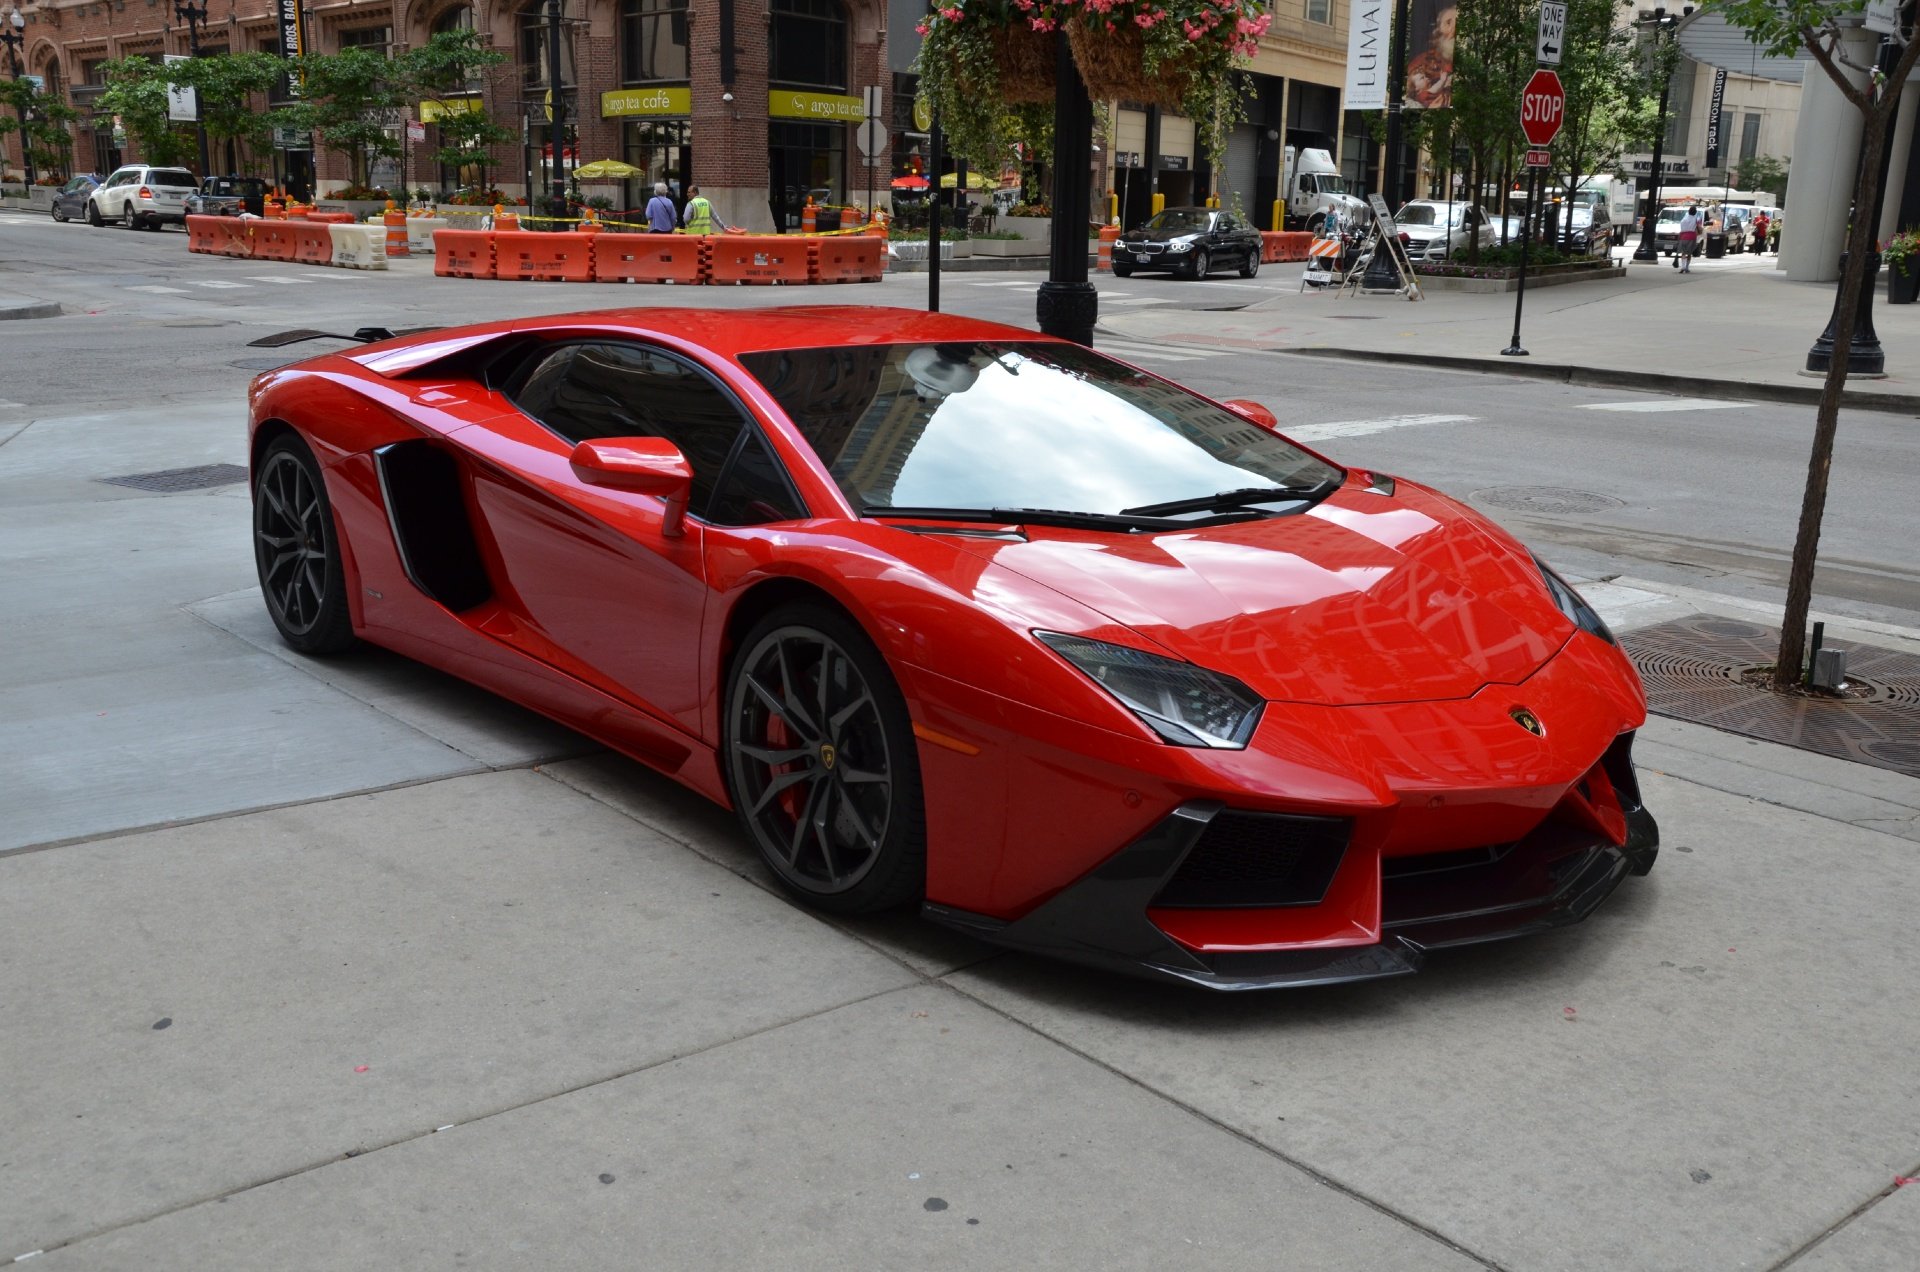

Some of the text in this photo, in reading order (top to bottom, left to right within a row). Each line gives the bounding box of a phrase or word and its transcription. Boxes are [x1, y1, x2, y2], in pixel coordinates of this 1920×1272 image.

[1544, 7, 1563, 23] ONE
[285, 23, 298, 49] BROS.
[1542, 23, 1562, 40] WAY
[1358, 7, 1380, 86] LUMA
[610, 89, 670, 114] argo tea café
[811, 101, 835, 117] argo
[837, 102, 849, 114] tea
[1524, 93, 1561, 122] STOP
[1708, 126, 1718, 150] rack
[1528, 153, 1548, 163] ALL WAY
